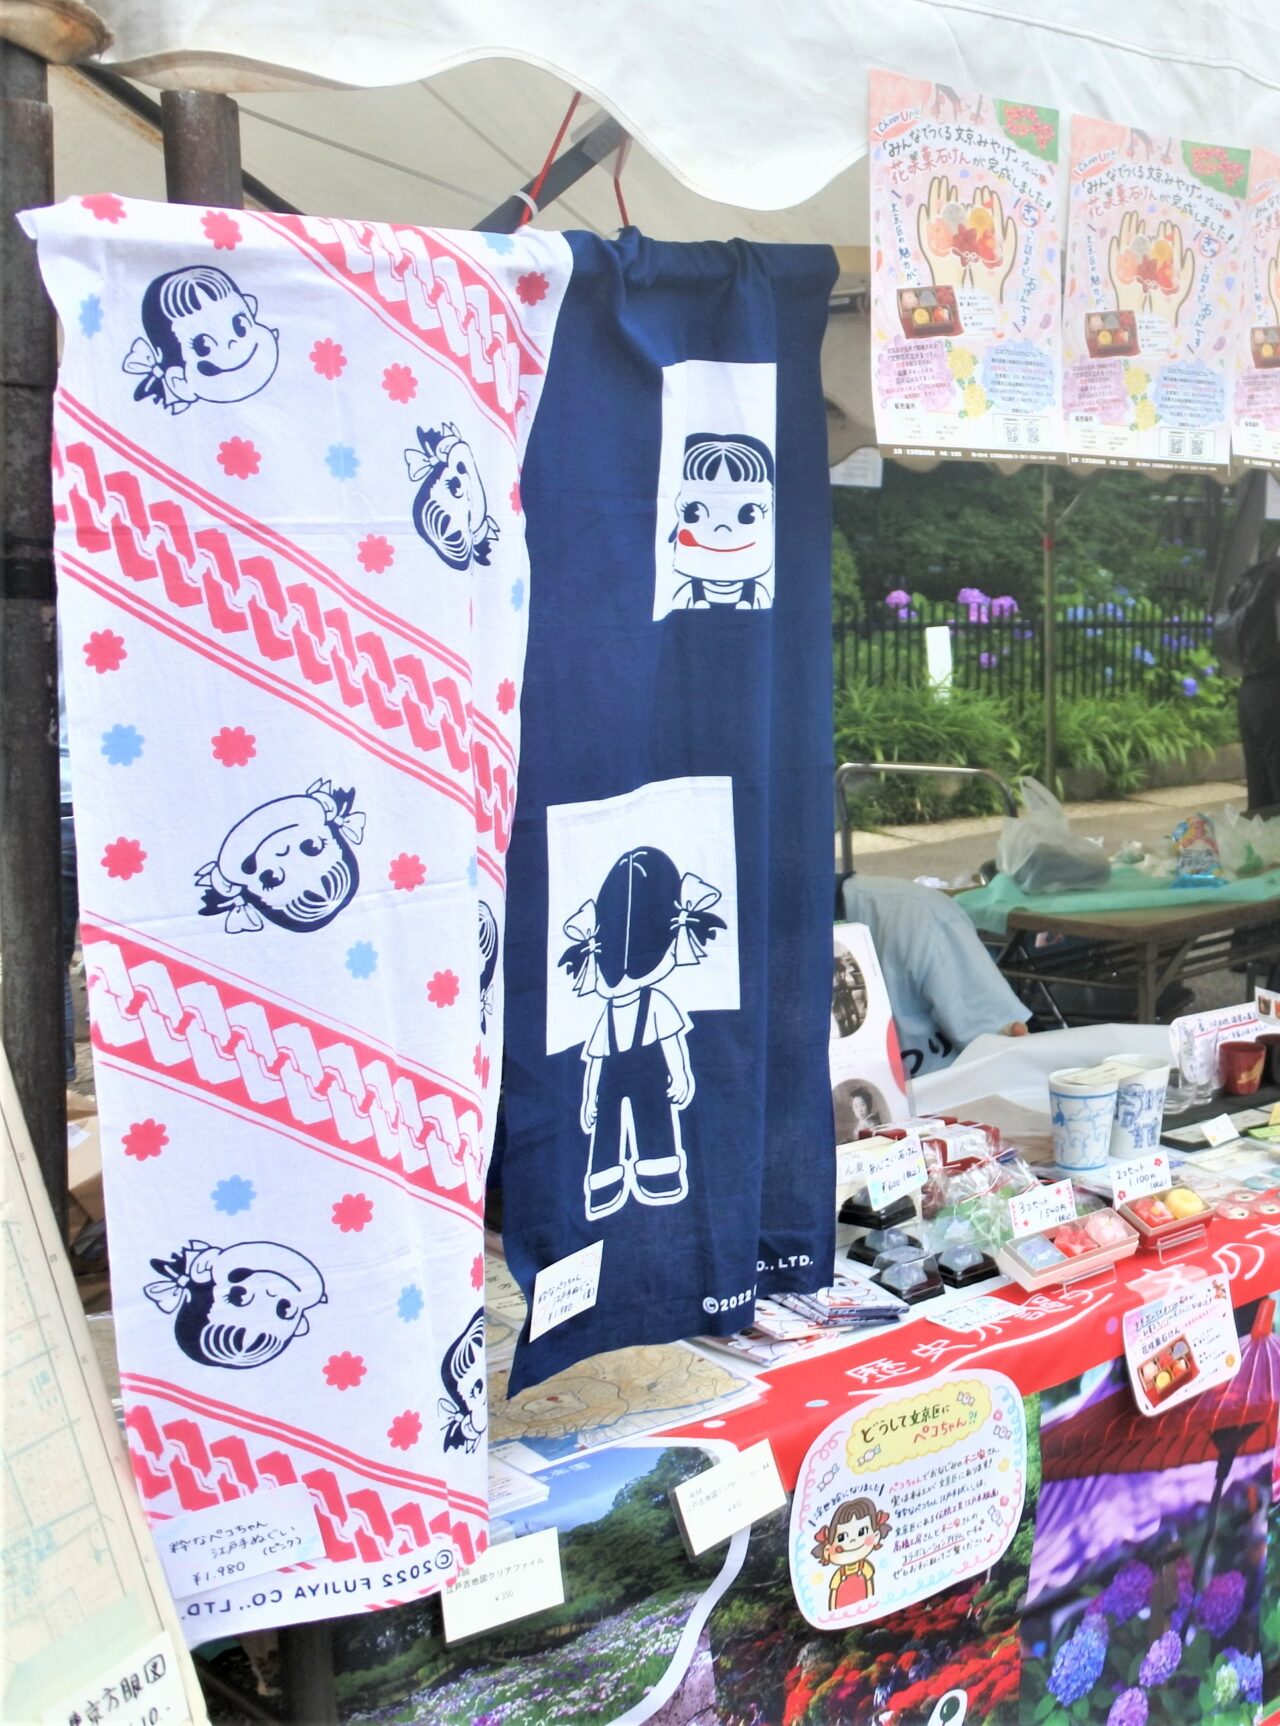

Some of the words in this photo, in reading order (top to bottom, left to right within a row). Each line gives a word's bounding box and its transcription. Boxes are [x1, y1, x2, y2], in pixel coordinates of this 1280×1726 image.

[778, 1254, 814, 1269] LTD.
[861, 1404, 951, 1444] どうして文京区に
[211, 1525, 297, 1560] 江戸手ぬぐい
[262, 1535, 303, 1557] (ピンク)
[446, 1556, 545, 1595] 江戸古地図クリアファイル
